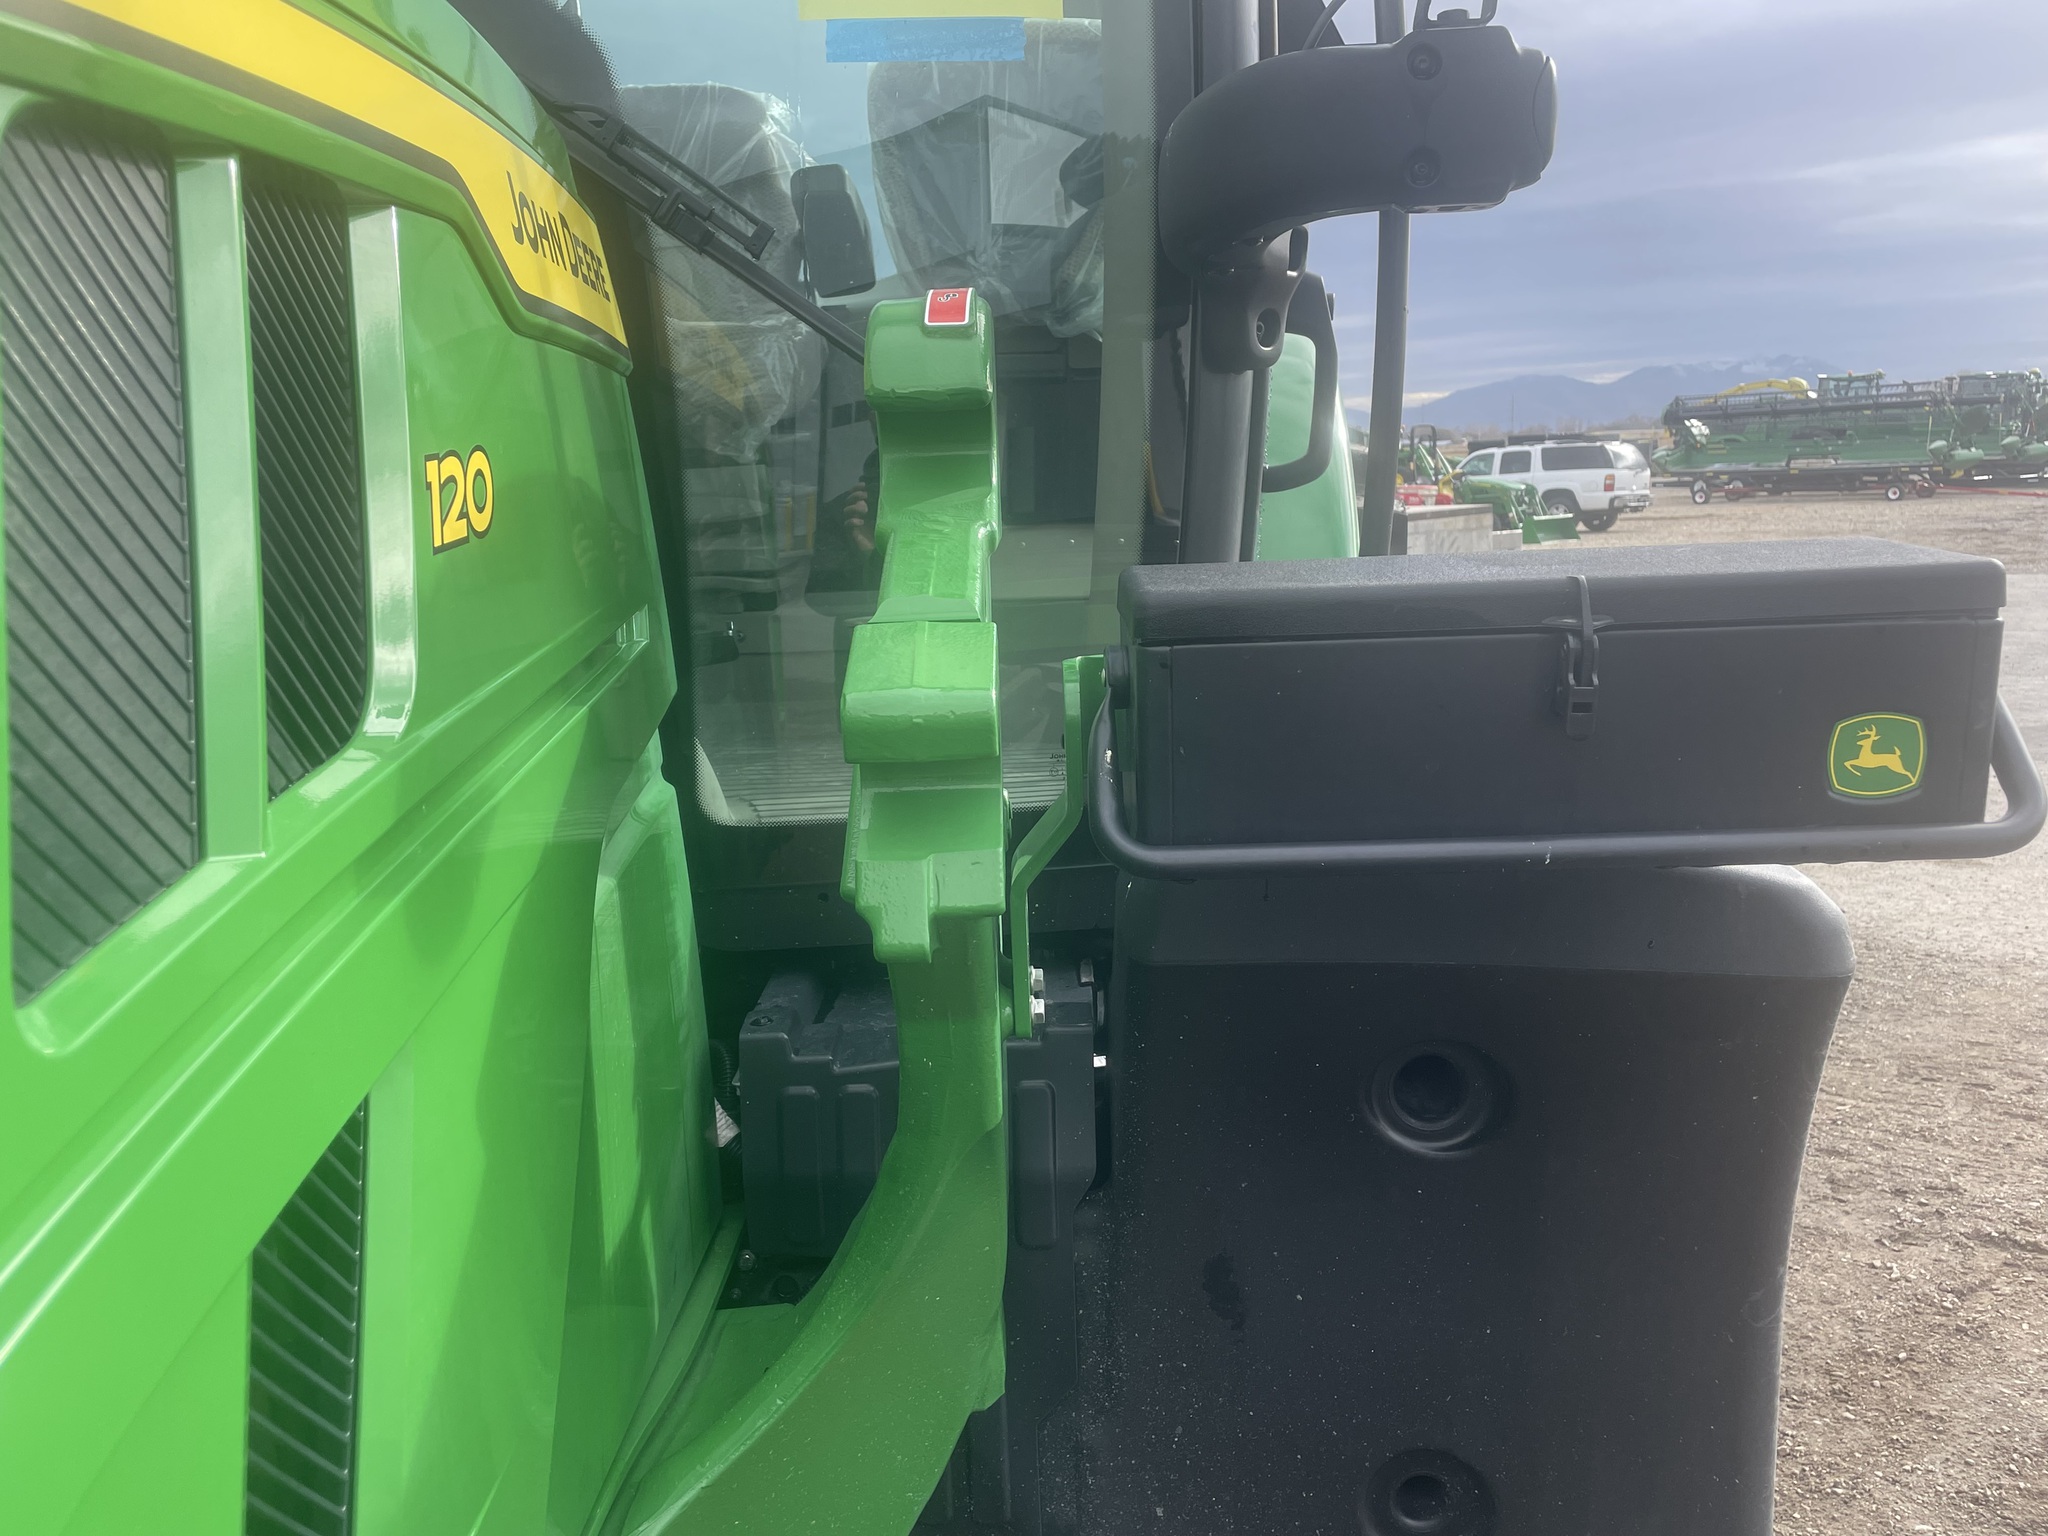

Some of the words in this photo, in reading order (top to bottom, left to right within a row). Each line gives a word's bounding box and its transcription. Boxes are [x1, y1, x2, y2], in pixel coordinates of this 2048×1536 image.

[506, 170, 567, 272] JOHN
[557, 210, 611, 303] DEERE
[424, 445, 494, 556] 120
